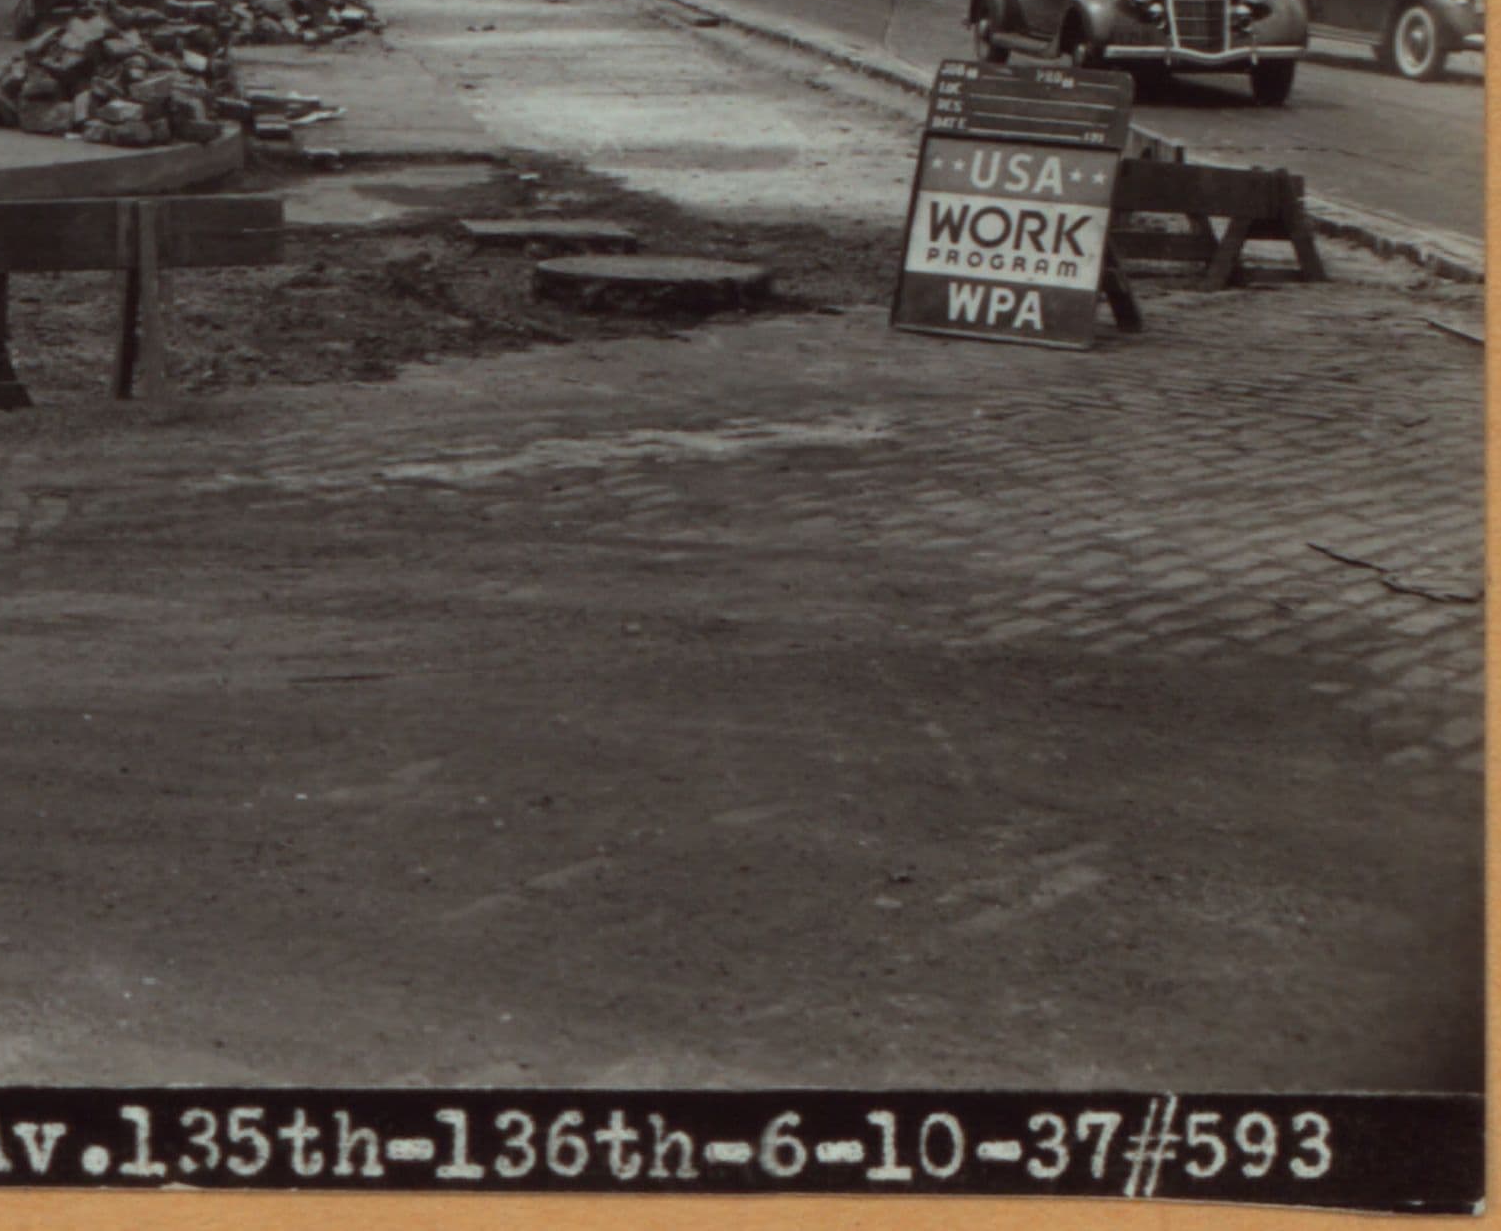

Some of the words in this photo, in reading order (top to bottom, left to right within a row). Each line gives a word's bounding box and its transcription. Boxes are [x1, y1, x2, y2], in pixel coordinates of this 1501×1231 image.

[969, 149, 1063, 196] USA
[928, 201, 1093, 257] WORK
[926, 247, 1078, 277] PROGRAM
[948, 282, 1043, 330] WPA
